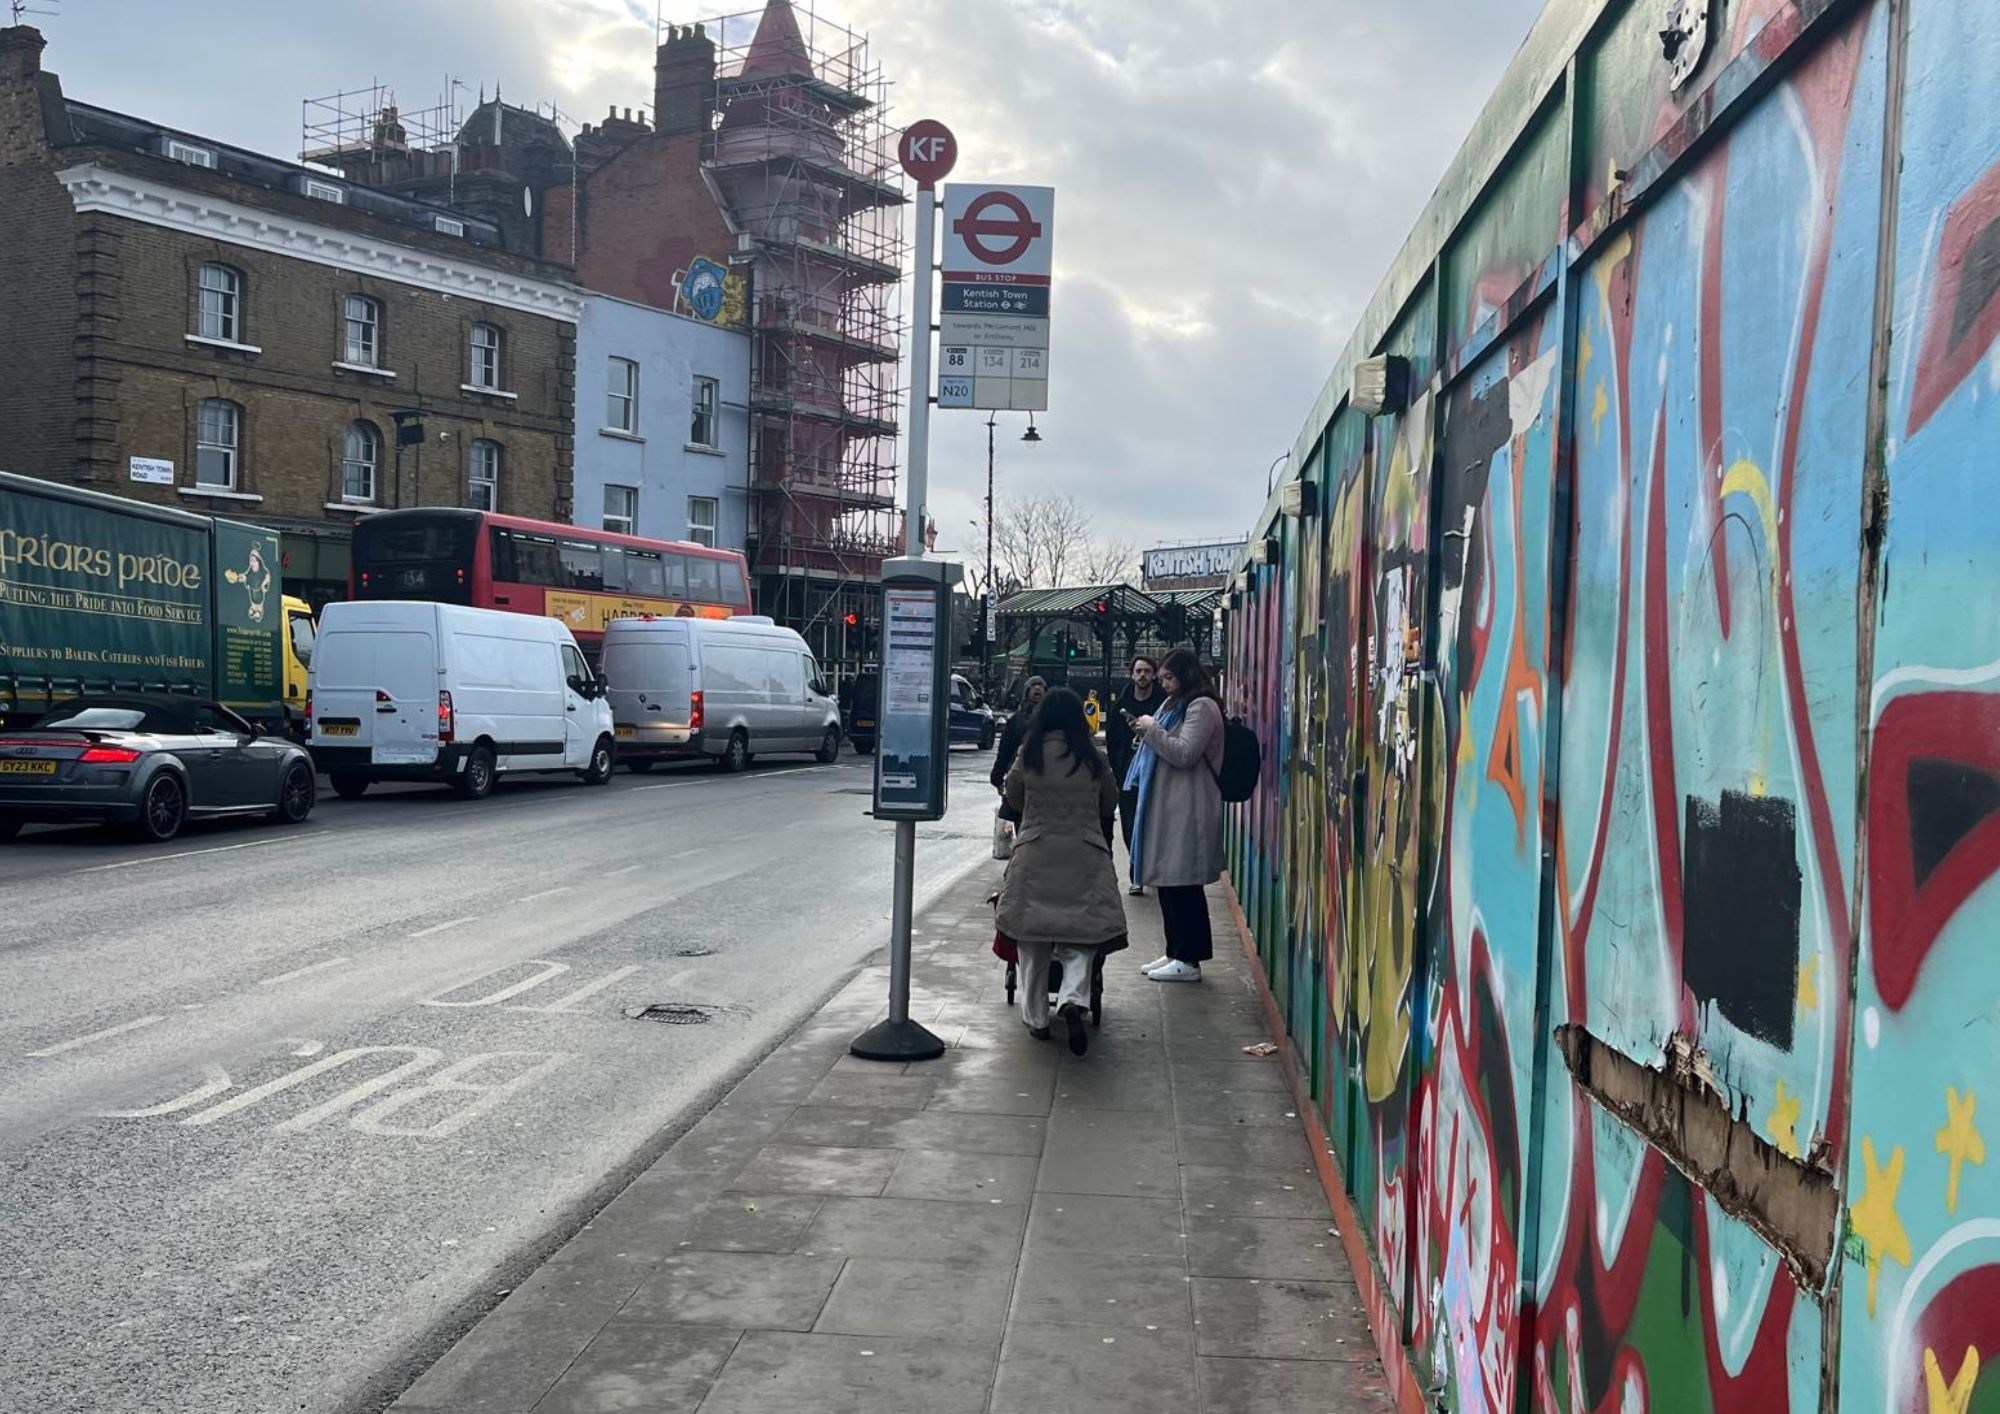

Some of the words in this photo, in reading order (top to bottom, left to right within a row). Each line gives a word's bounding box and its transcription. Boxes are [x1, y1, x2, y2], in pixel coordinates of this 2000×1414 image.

[909, 136, 946, 162] KF
[975, 273, 993, 281] BUS
[995, 274, 1018, 282] STOP
[963, 288, 1000, 299] Kentish
[1002, 290, 1028, 299] Town
[963, 299, 998, 309] Station
[949, 354, 964, 366] 88
[984, 356, 1004, 367] 134
[1020, 358, 1040, 369] 214
[943, 385, 969, 397] N20
[1147, 549, 1206, 578] KENTISH
[118, 553, 201, 589] pride
[50, 592, 73, 608] THE
[75, 592, 108, 612] PRIDE
[111, 599, 135, 615] INTO
[137, 601, 164, 618] FOOD
[164, 604, 203, 622] SERVICE
[0, 642, 48, 659] SUPPLIERS
[50, 648, 62, 660] TO
[101, 649, 142, 665] CATERERS
[144, 655, 160, 666] AND
[160, 654, 178, 668] FISH
